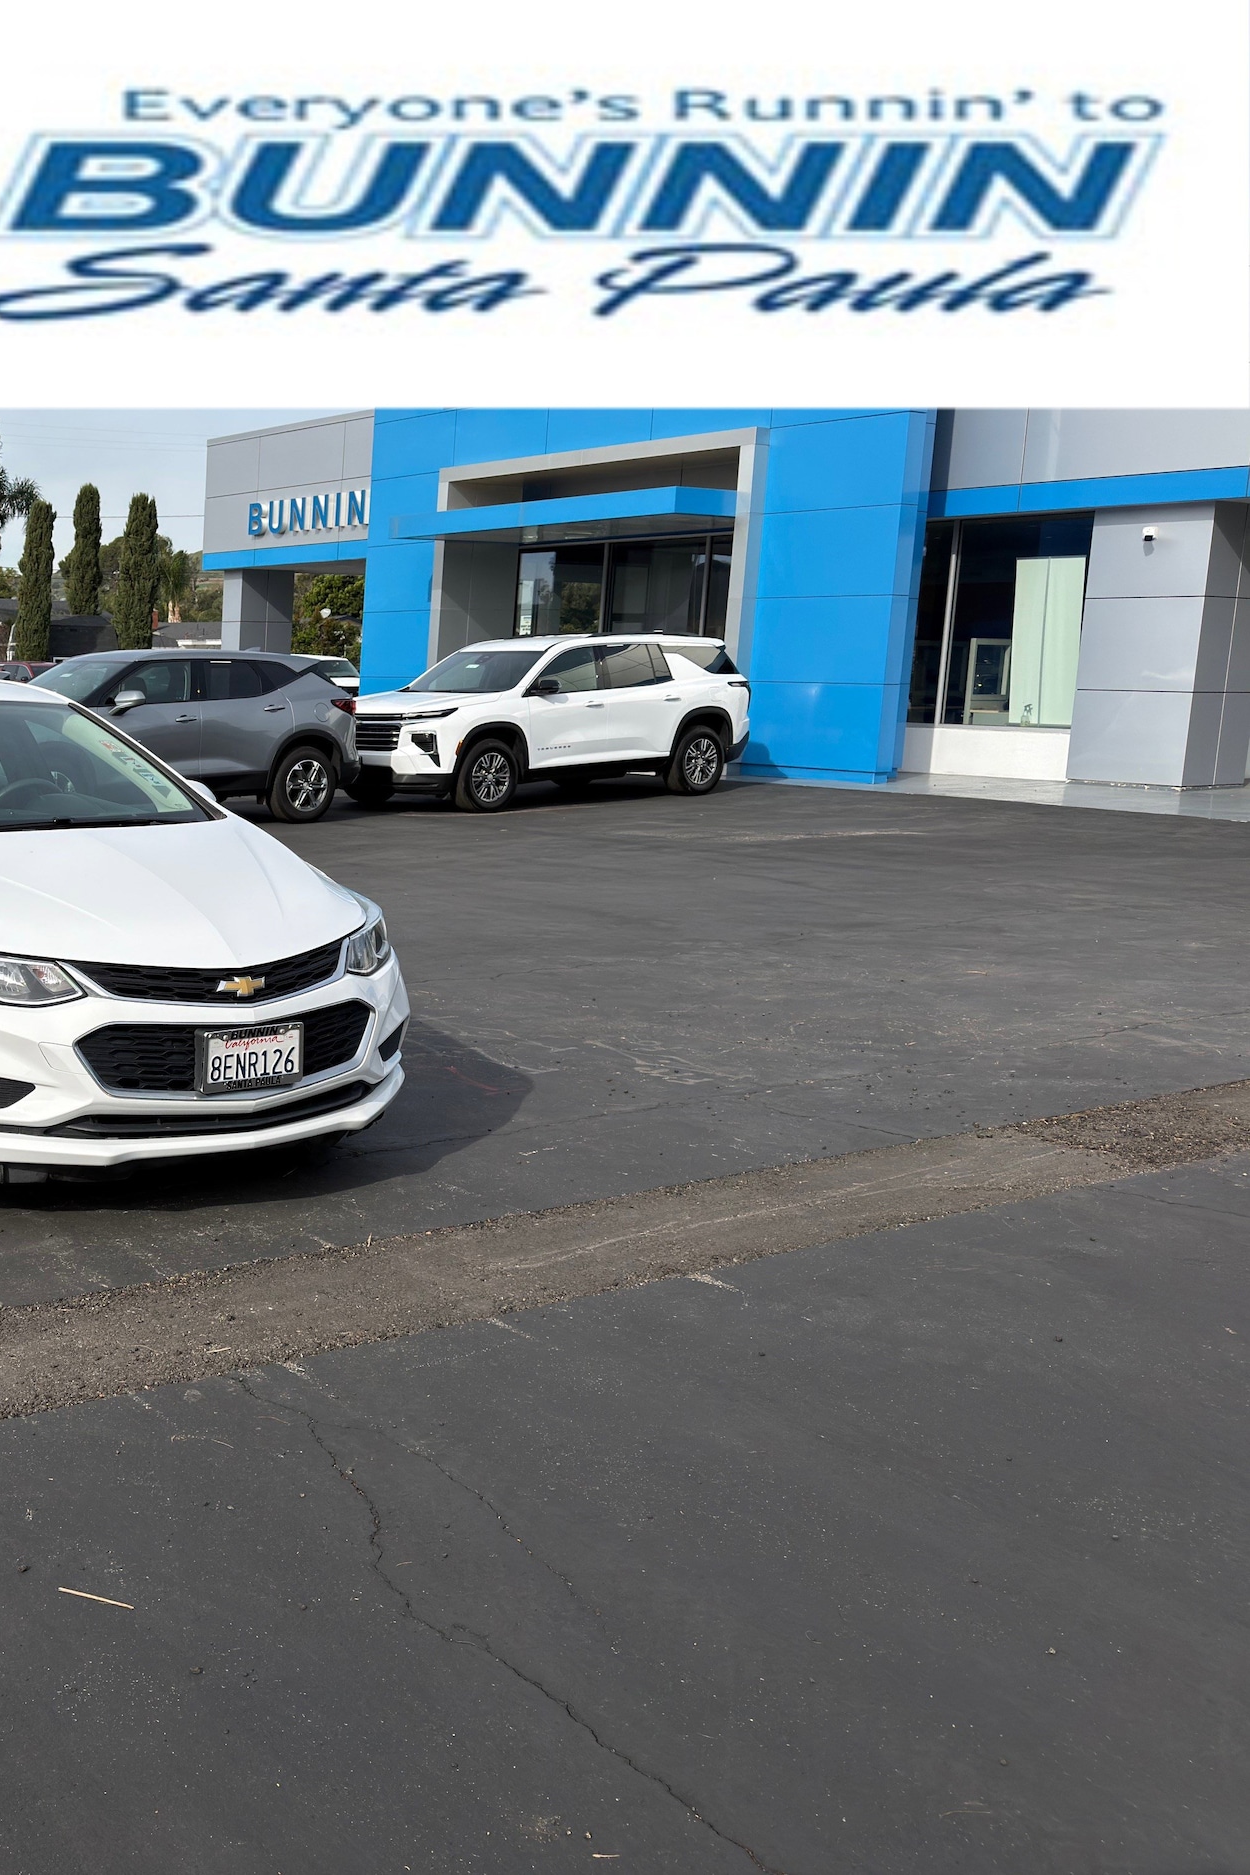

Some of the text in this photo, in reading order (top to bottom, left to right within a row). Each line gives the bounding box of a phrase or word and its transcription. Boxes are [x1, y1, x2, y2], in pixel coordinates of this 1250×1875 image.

[248, 489, 370, 537] BUNNIN
[230, 1026, 280, 1040] BUNNIN
[225, 1035, 285, 1051] California
[210, 1046, 296, 1082] 8ENR126
[226, 1075, 281, 1091] SANTA PAULA
